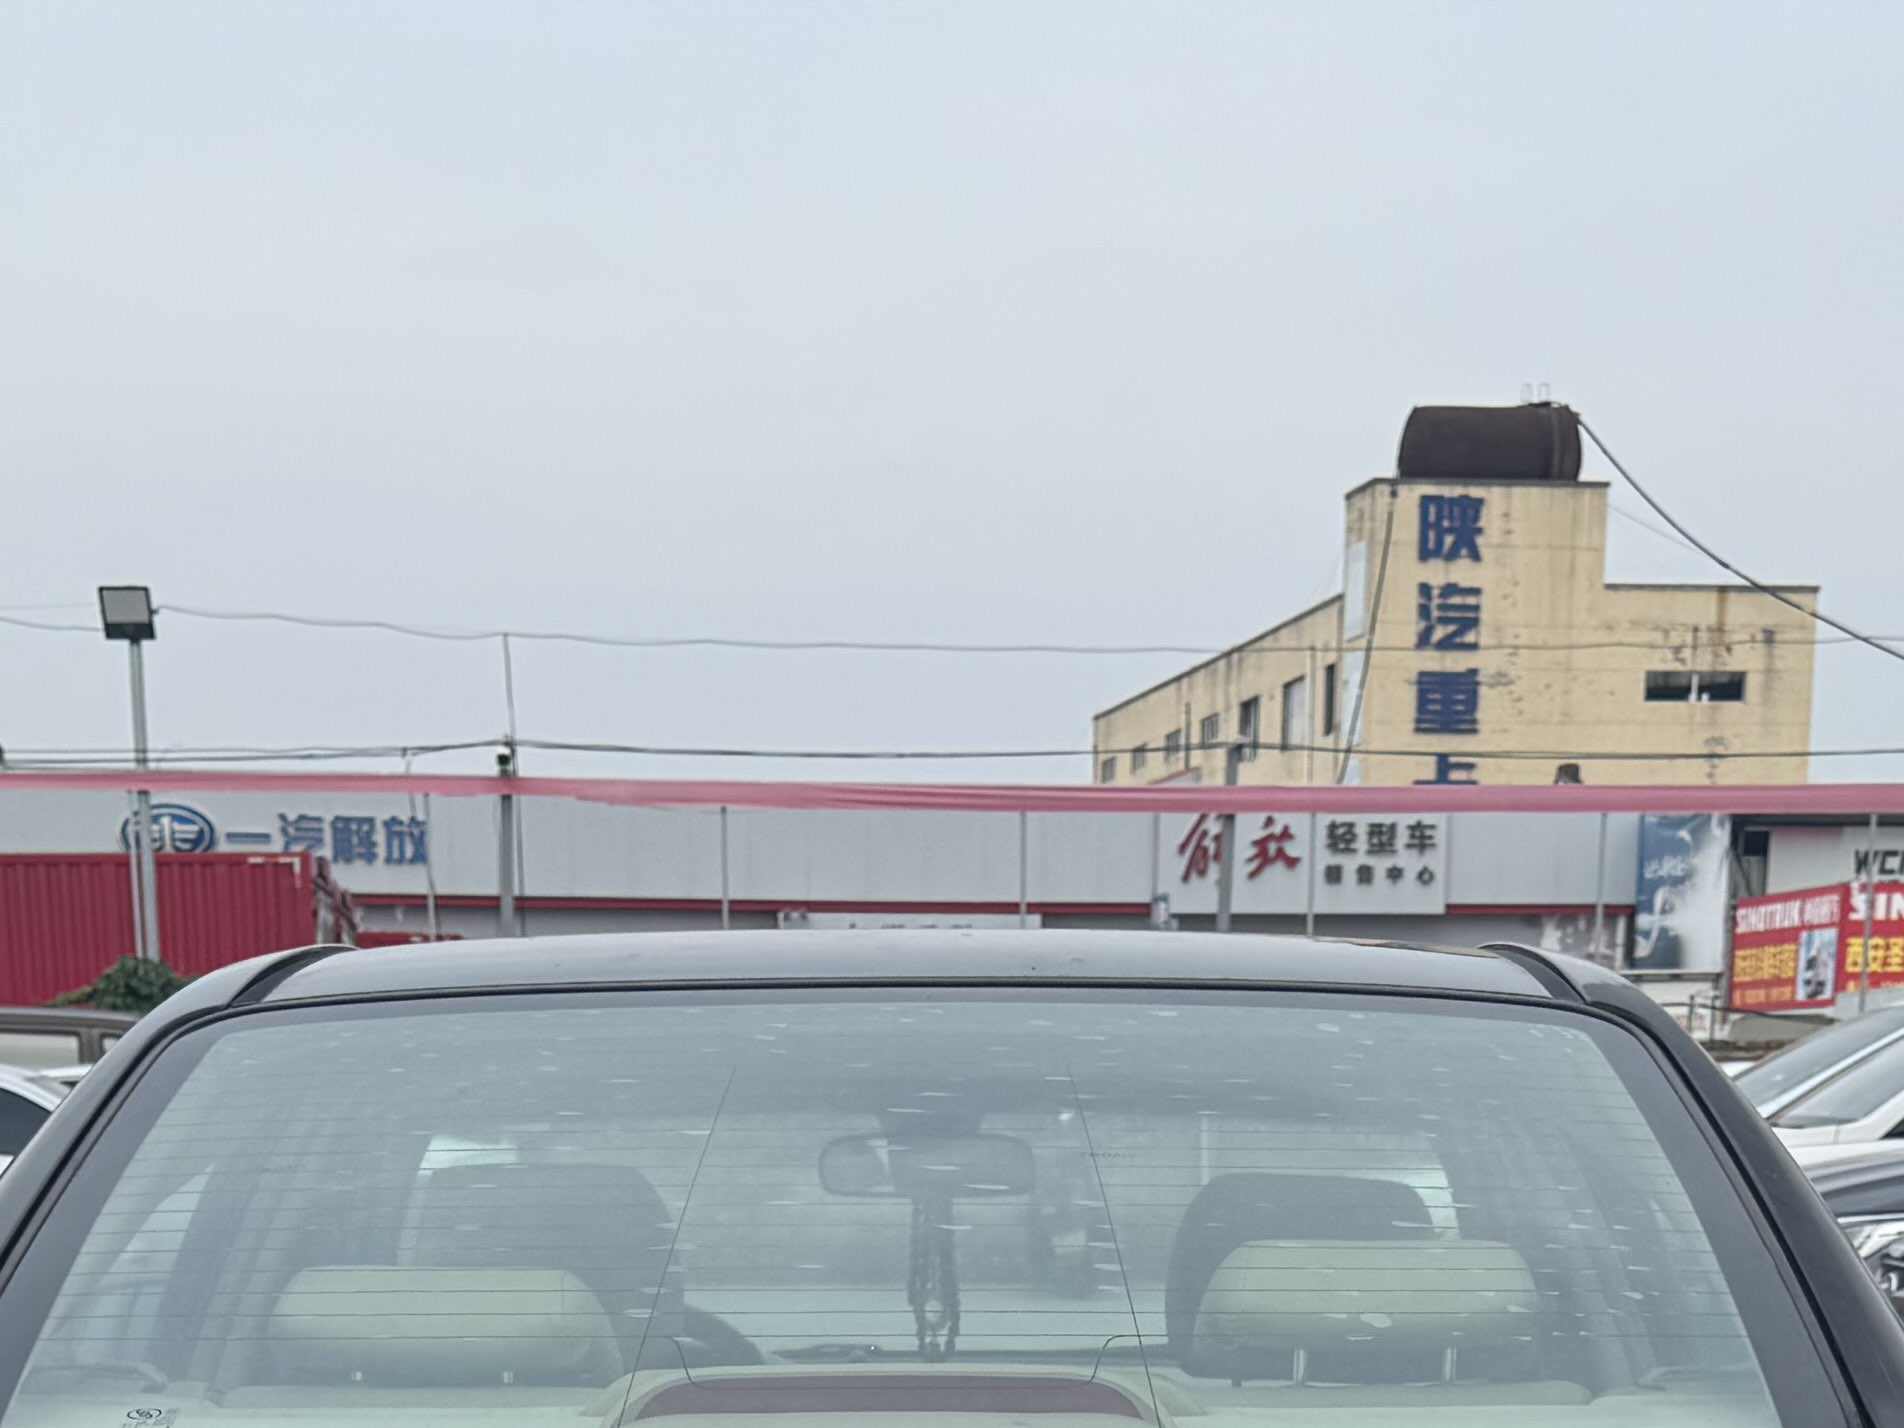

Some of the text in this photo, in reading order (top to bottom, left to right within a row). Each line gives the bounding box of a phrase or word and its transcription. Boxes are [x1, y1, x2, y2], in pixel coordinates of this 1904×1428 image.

[225, 813, 427, 865] 一汽解放
[1325, 820, 1438, 856] 轻型车
